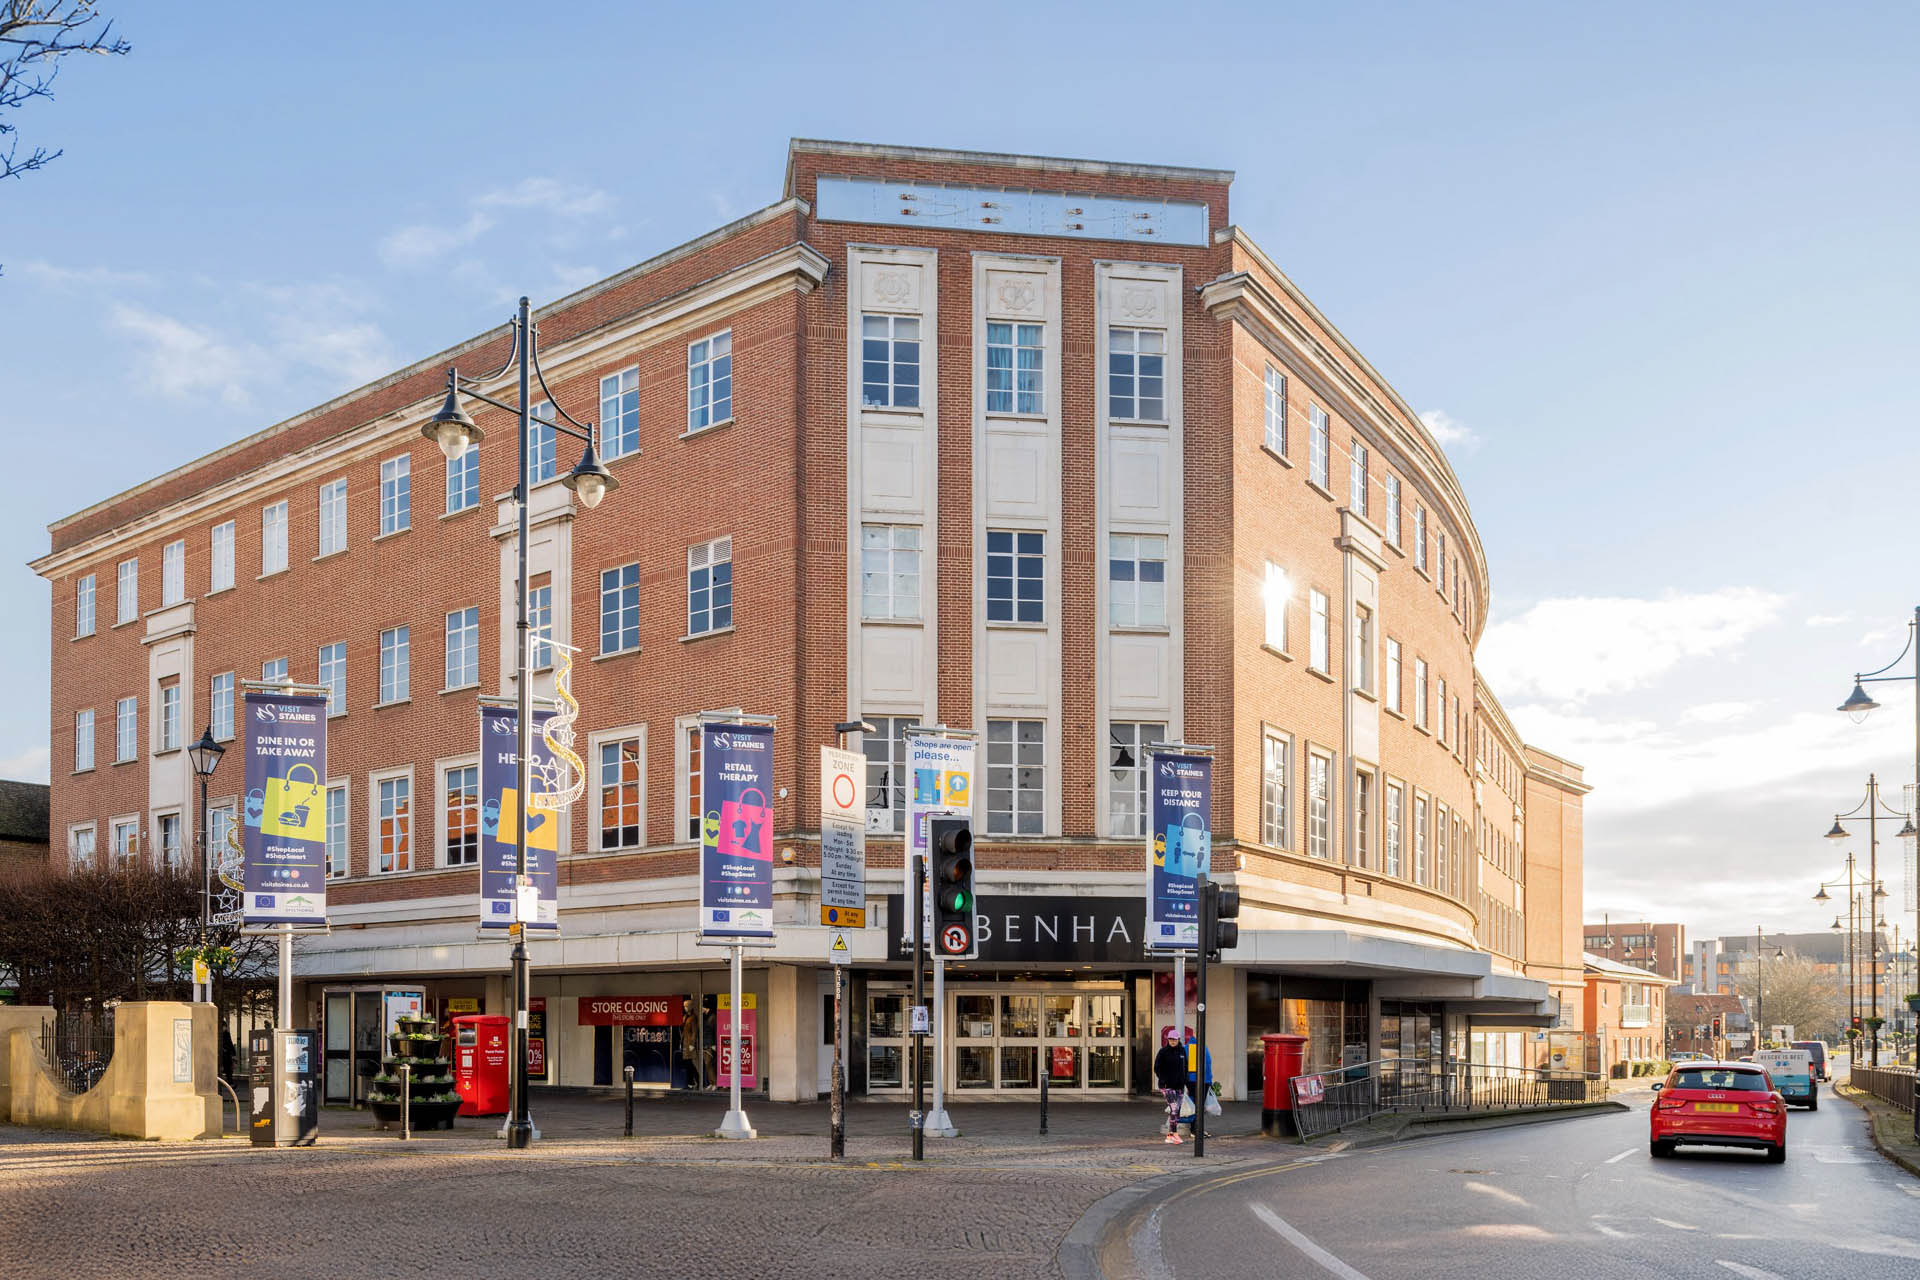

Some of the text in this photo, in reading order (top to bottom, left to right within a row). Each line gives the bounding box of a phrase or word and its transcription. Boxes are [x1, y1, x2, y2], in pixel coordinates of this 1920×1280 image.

[279, 705, 300, 713] VISIT
[279, 712, 316, 721] STAINES
[257, 736, 315, 747] DINE IN OR
[732, 741, 765, 749] STAINES
[914, 740, 937, 749] Shops
[256, 746, 316, 758] TAKE AWAY
[498, 752, 541, 765] HEO
[724, 763, 753, 772] RETAIL
[832, 760, 855, 772] ZONE
[718, 772, 759, 782] THERAPY
[1161, 789, 1202, 798] KEEP YOUR
[1163, 798, 1200, 807] DISTANCE
[267, 846, 304, 854] #ShopLocal
[976, 914, 1131, 943] BENHA
[592, 1001, 668, 1013] STORE CLOSING
[722, 1047, 751, 1065] 5%
